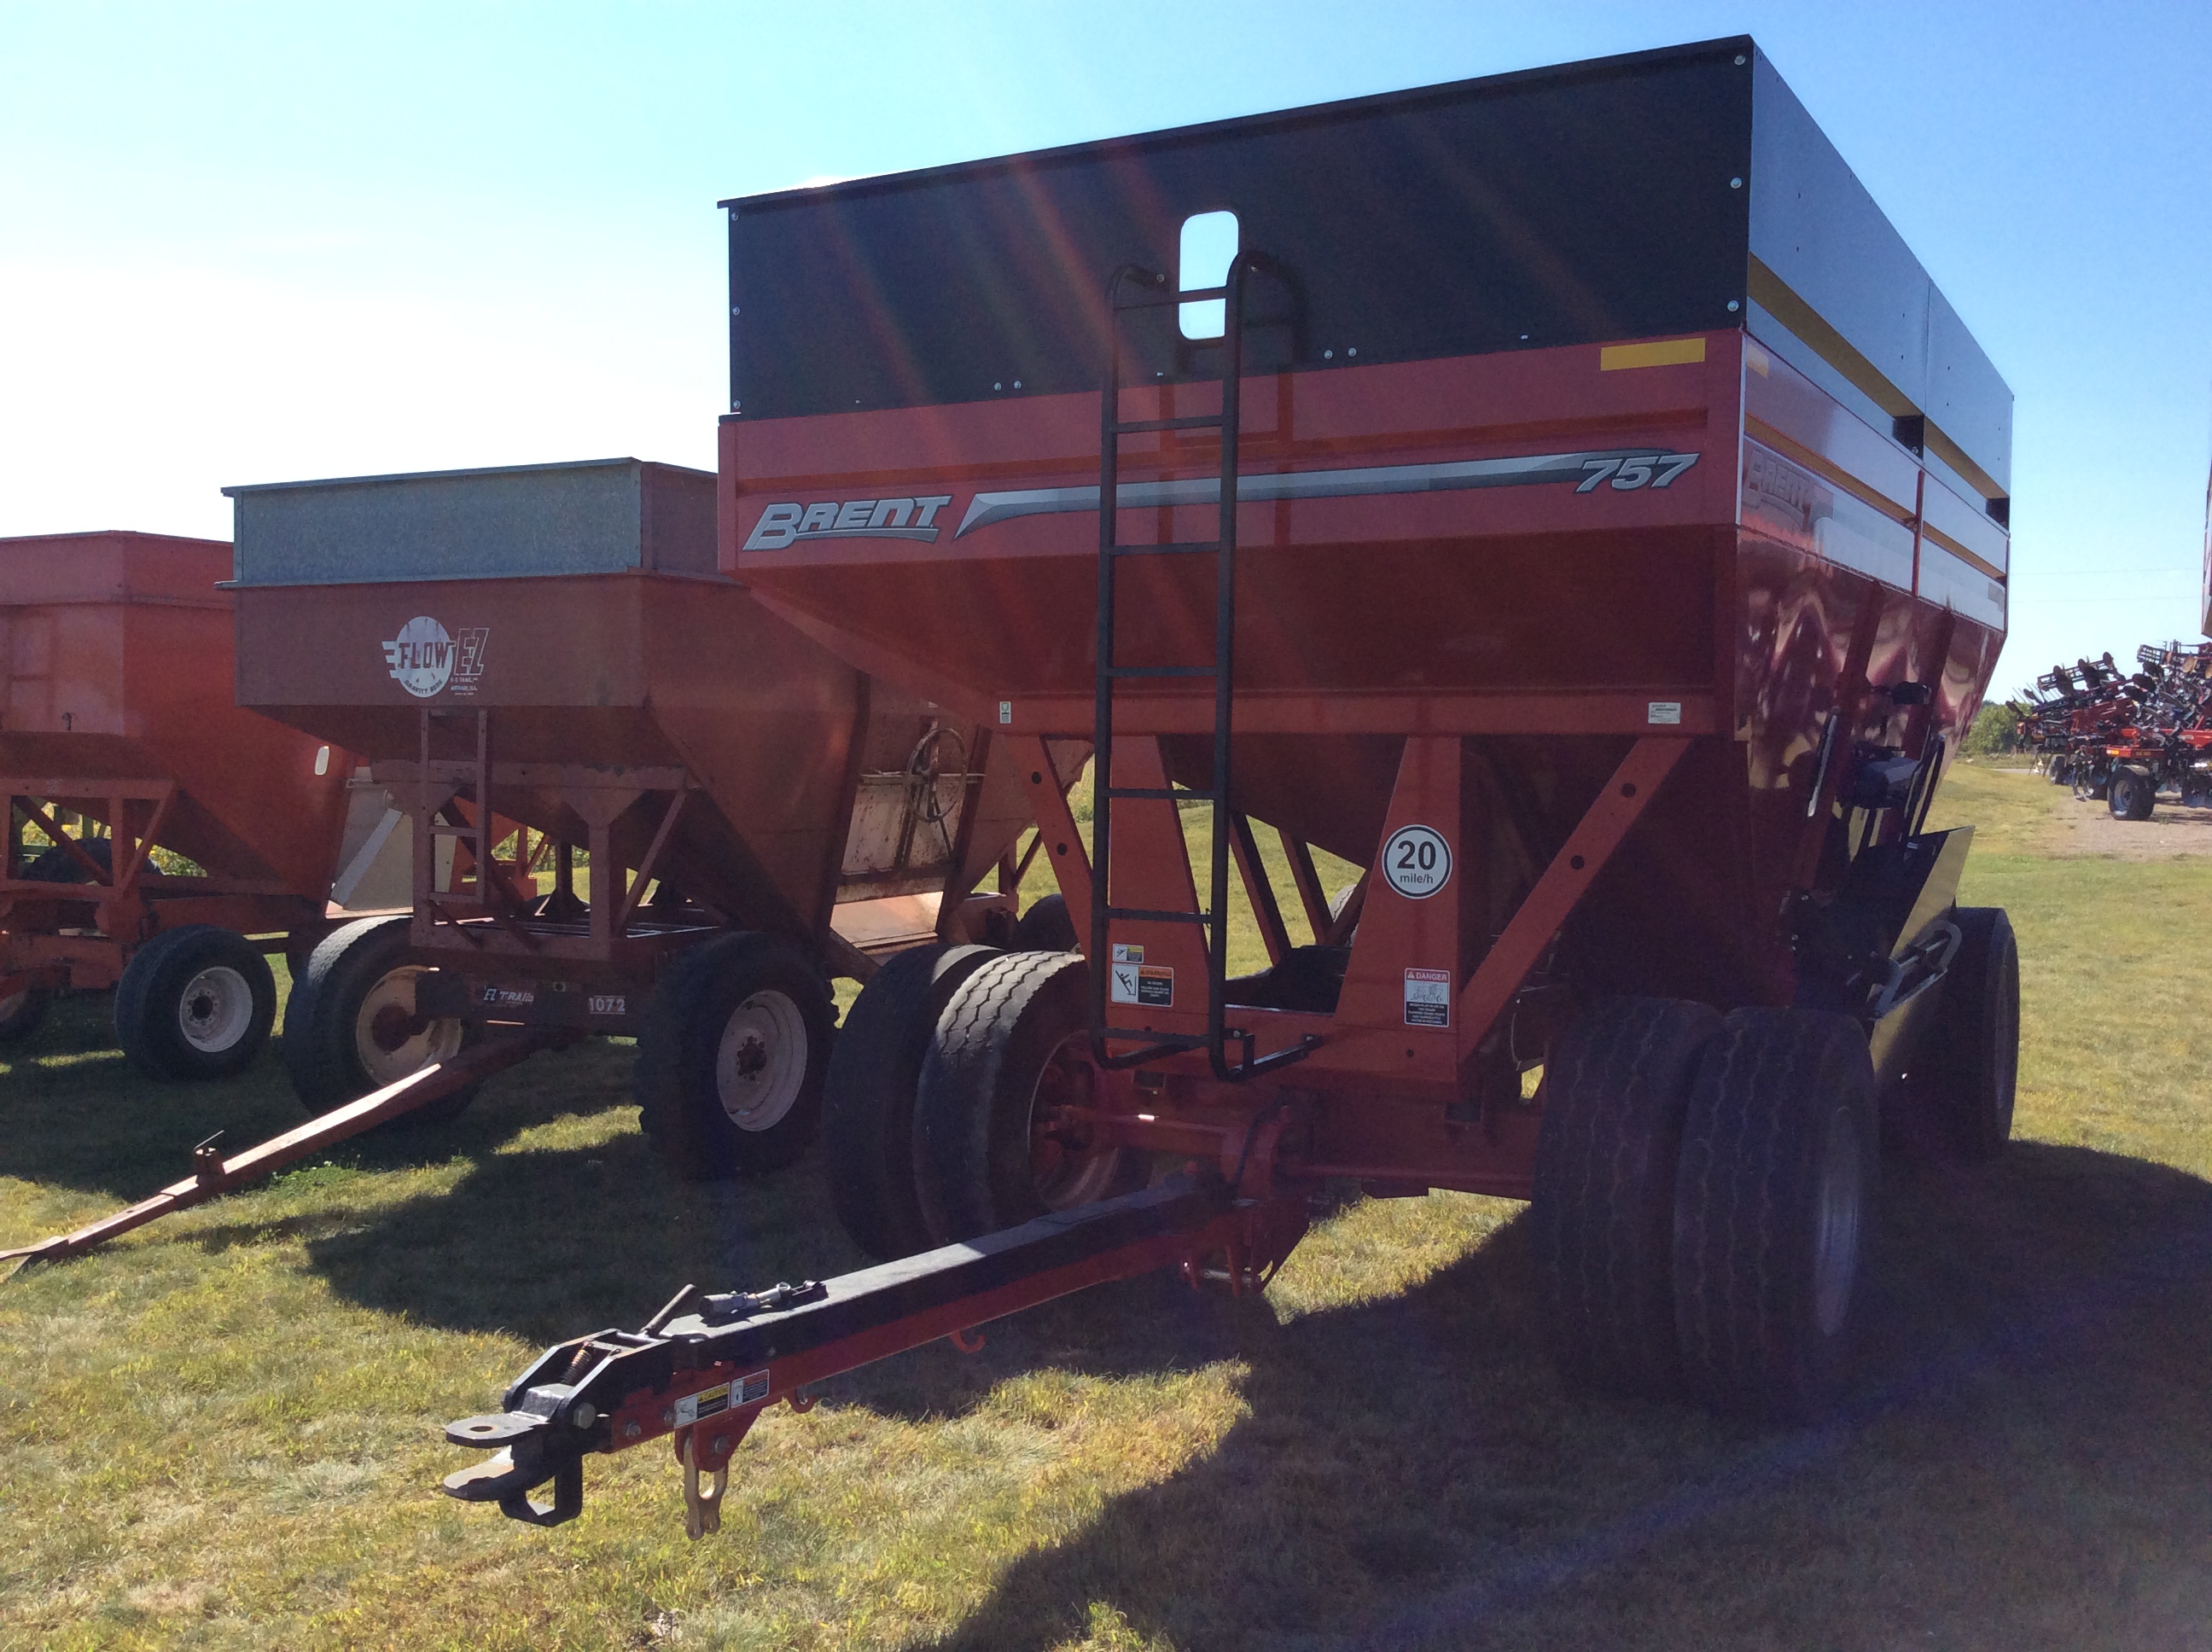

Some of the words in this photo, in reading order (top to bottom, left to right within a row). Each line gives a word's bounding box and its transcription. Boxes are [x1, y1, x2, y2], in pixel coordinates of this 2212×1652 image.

[1575, 453, 1701, 493] 757
[742, 495, 953, 551] BRENT
[398, 641, 456, 669] FLOW
[1397, 840, 1436, 870] 20
[1400, 873, 1434, 884] mile/h
[1417, 972, 1447, 981] DANGER
[588, 998, 626, 1012] 1072
